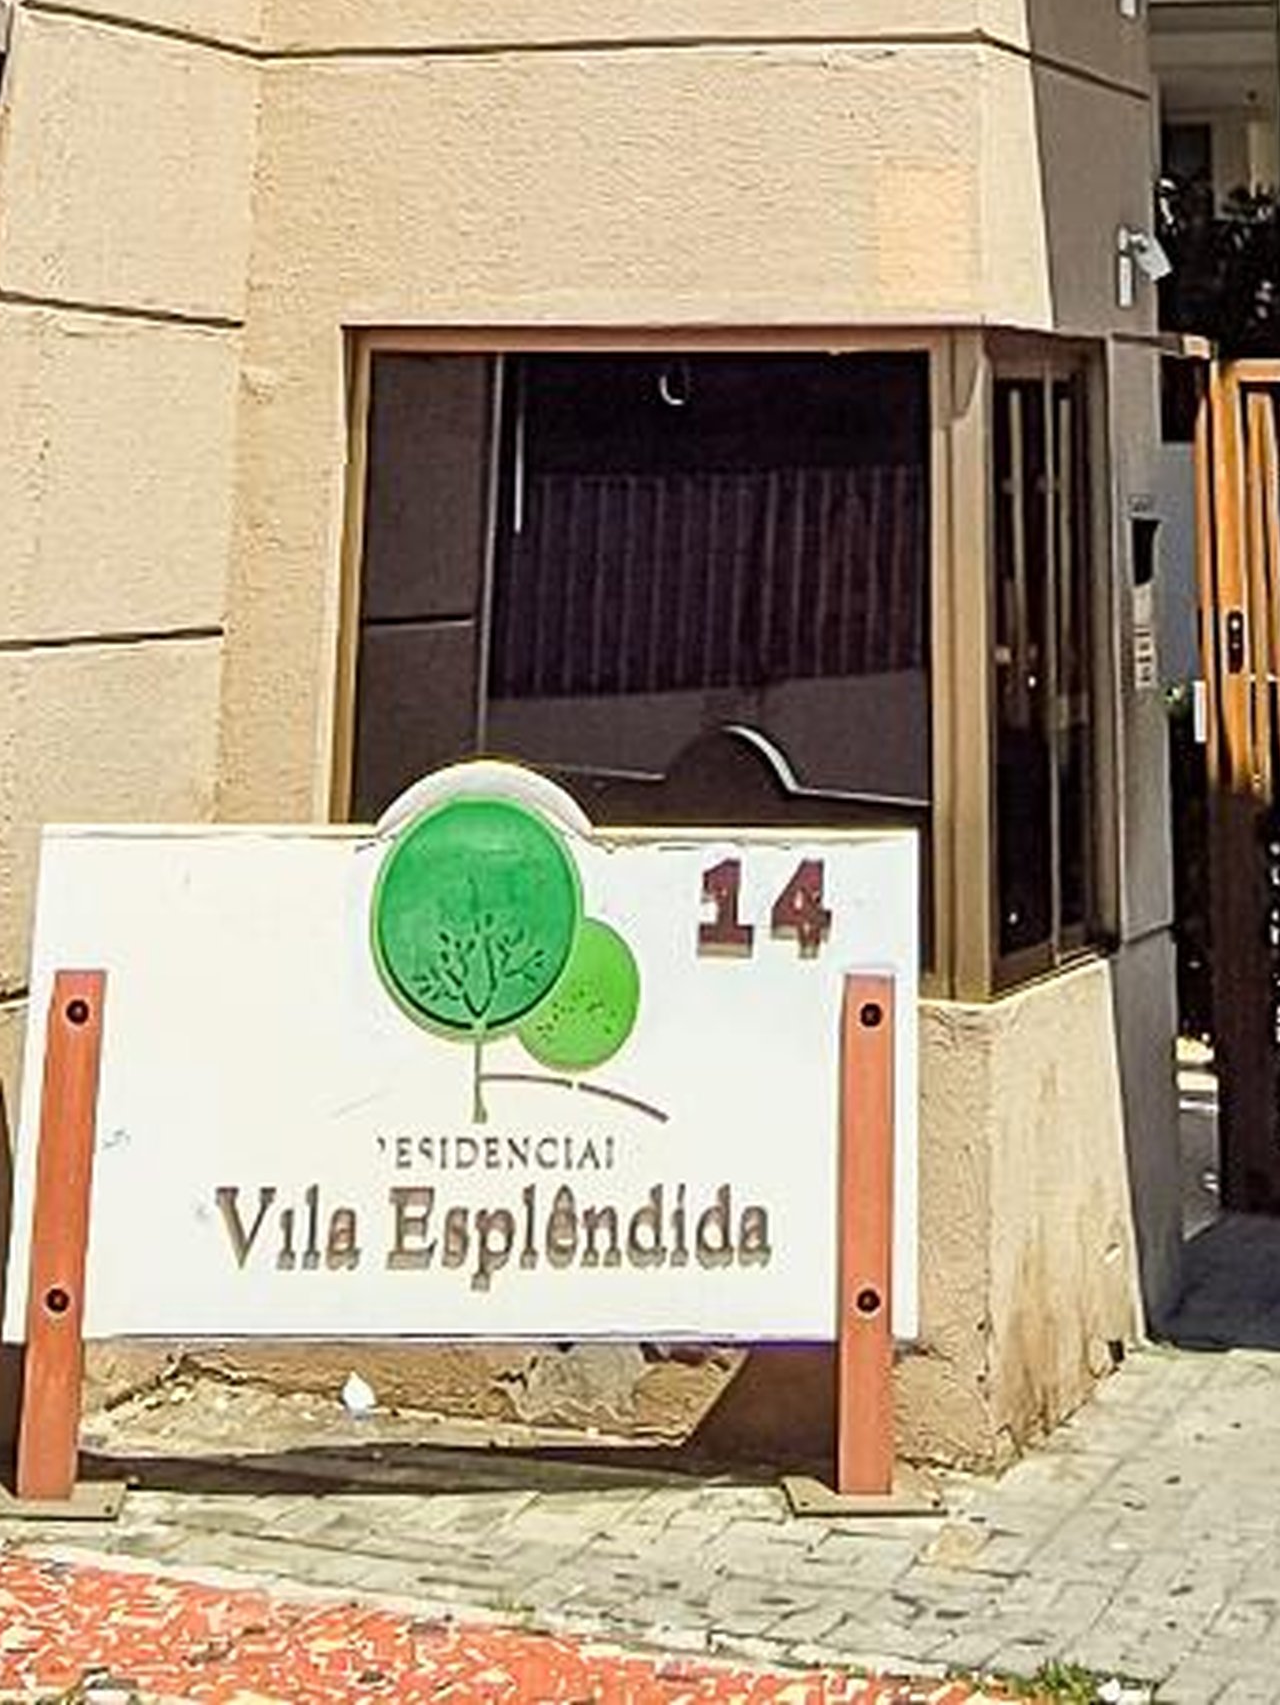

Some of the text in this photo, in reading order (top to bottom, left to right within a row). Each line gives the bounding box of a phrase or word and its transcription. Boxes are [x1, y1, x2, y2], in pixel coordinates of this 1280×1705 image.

[697, 857, 832, 959] 14
[214, 1184, 772, 1292] Vila Esplêndida
